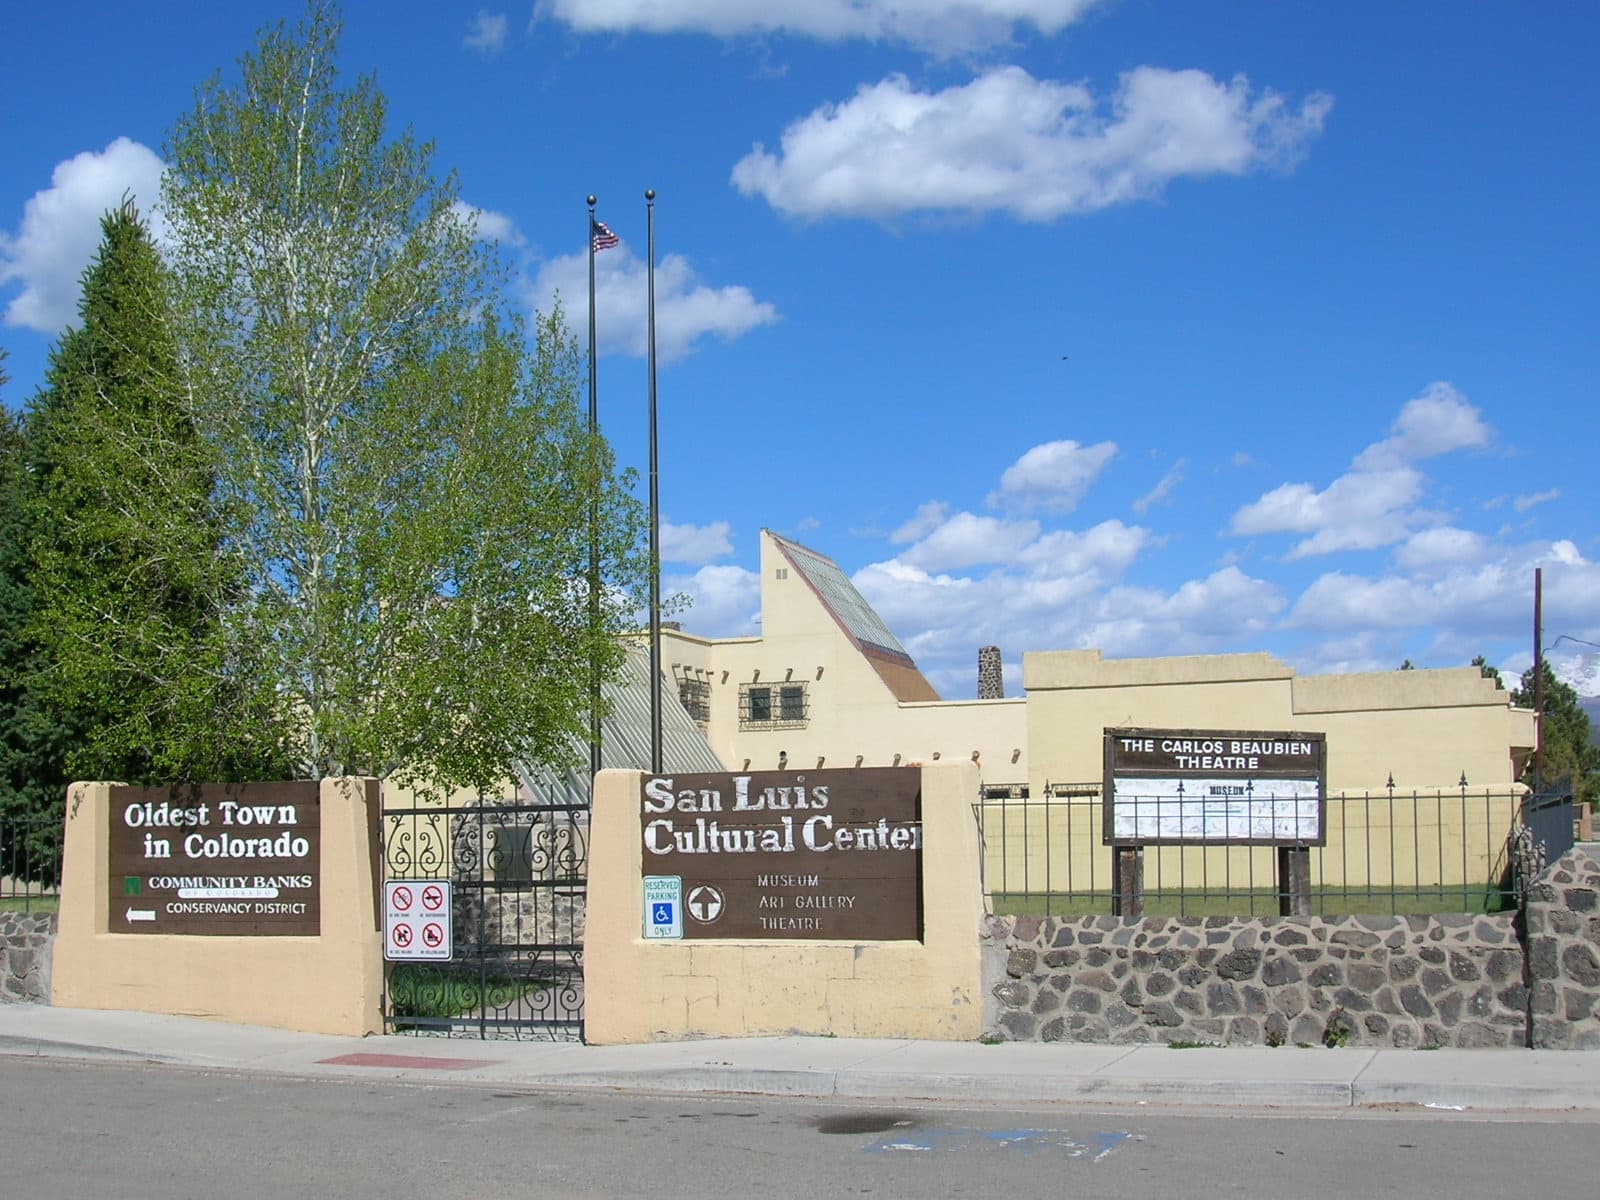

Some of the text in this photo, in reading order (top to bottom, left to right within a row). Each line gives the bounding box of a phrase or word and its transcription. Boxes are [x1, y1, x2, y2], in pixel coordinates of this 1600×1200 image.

[1121, 739, 1312, 755] THE CARLOS BEAUBIEN
[1176, 756, 1259, 769] THEATRE
[644, 775, 829, 813] San Luis
[124, 801, 297, 828] Oldest Town
[644, 816, 795, 855] Cultural
[143, 832, 309, 858] in Colorado
[148, 875, 312, 889] COMMUNITY BANKS
[645, 881, 679, 890] RESERVED
[757, 874, 819, 887] MUSEUM
[647, 892, 678, 900] PARKING
[759, 895, 856, 909] ART GALLERY
[166, 902, 307, 914] CONSERVANCY DISTRICT
[759, 916, 823, 930] THEATRE
[654, 927, 672, 935] ONLY
